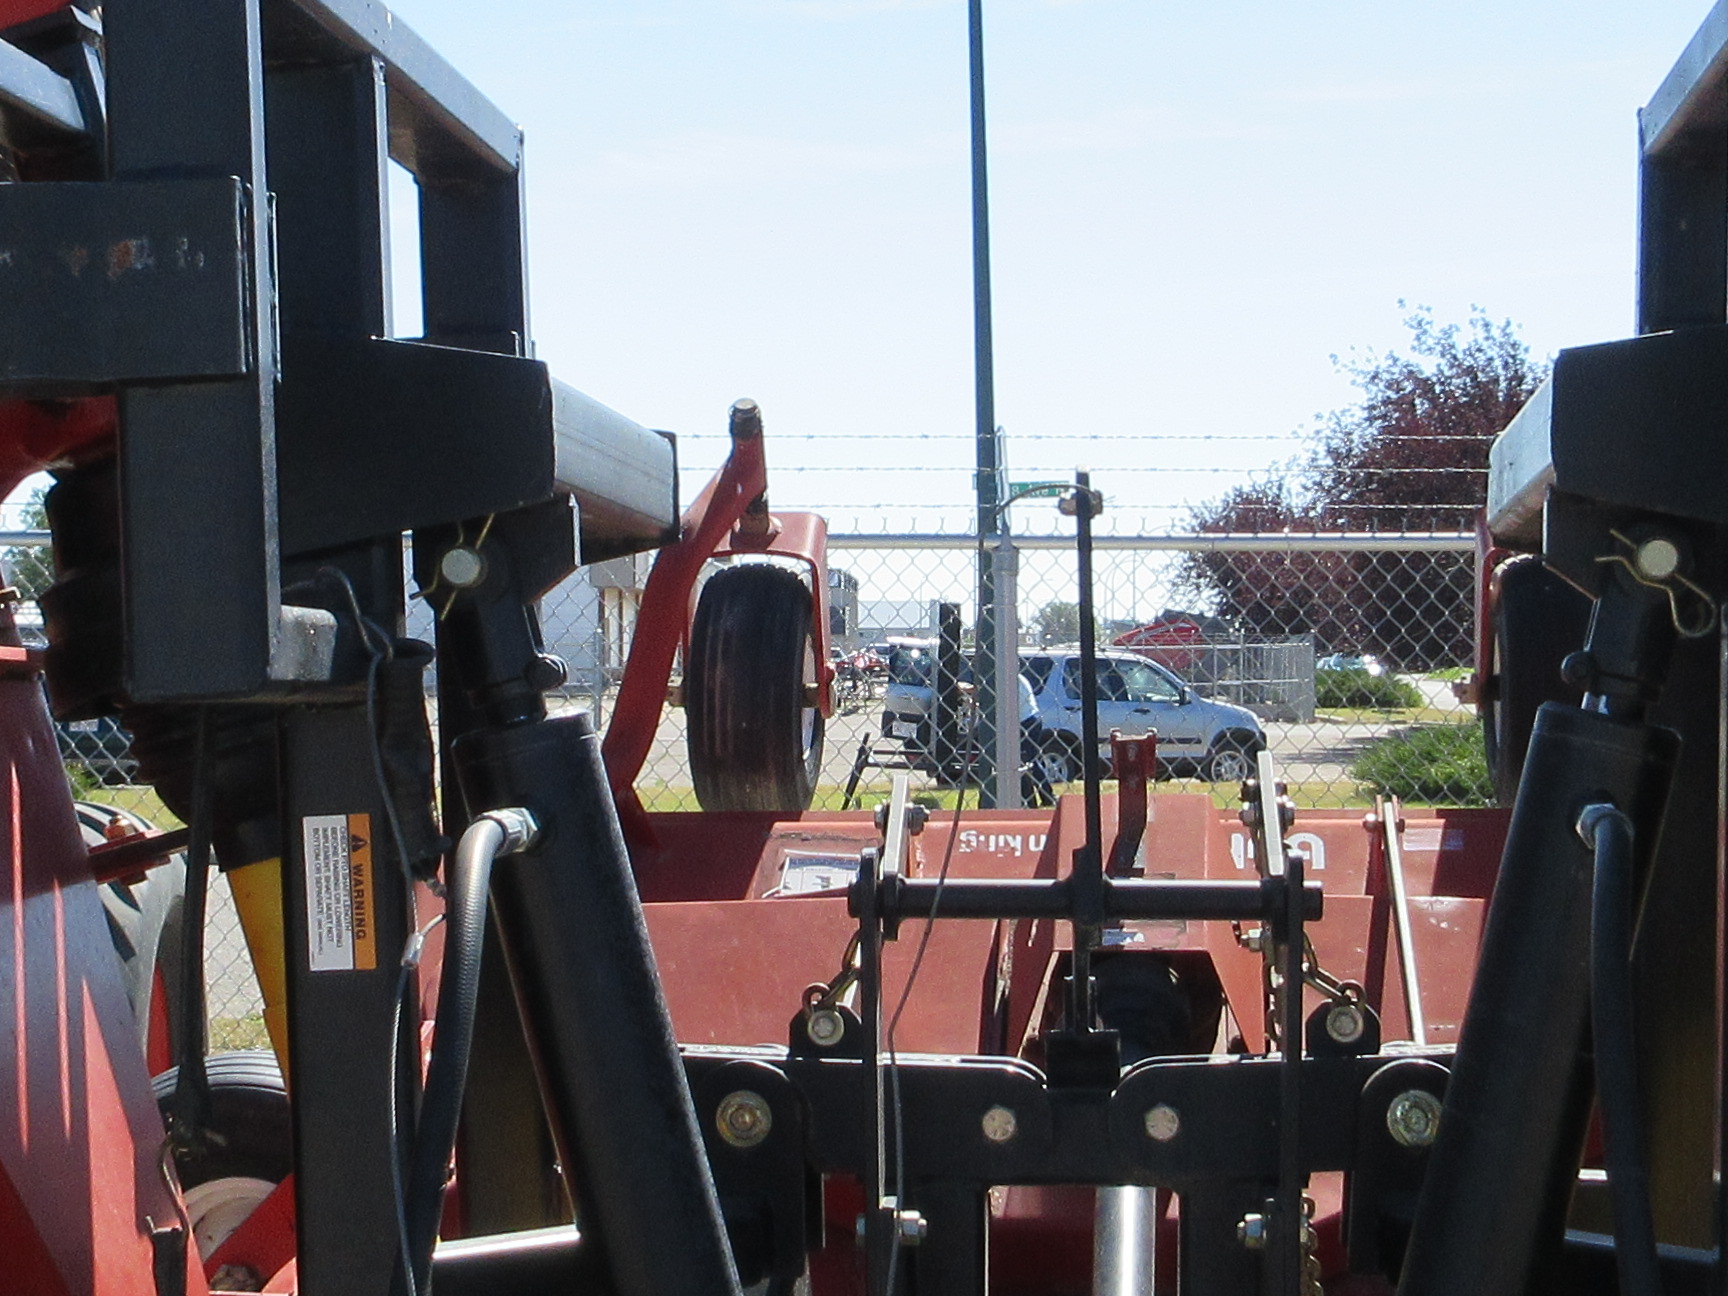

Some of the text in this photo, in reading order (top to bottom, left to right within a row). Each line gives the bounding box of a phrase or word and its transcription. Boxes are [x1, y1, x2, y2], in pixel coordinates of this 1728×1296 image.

[313, 827, 322, 861] BOTTOM
[331, 826, 339, 858] BEFORE
[315, 862, 322, 874] OR
[334, 892, 342, 904] OR
[353, 863, 367, 940] WARNING
[334, 905, 343, 948] LOWERING
[343, 899, 352, 931] LENGTH
[326, 925, 335, 942] NOT
